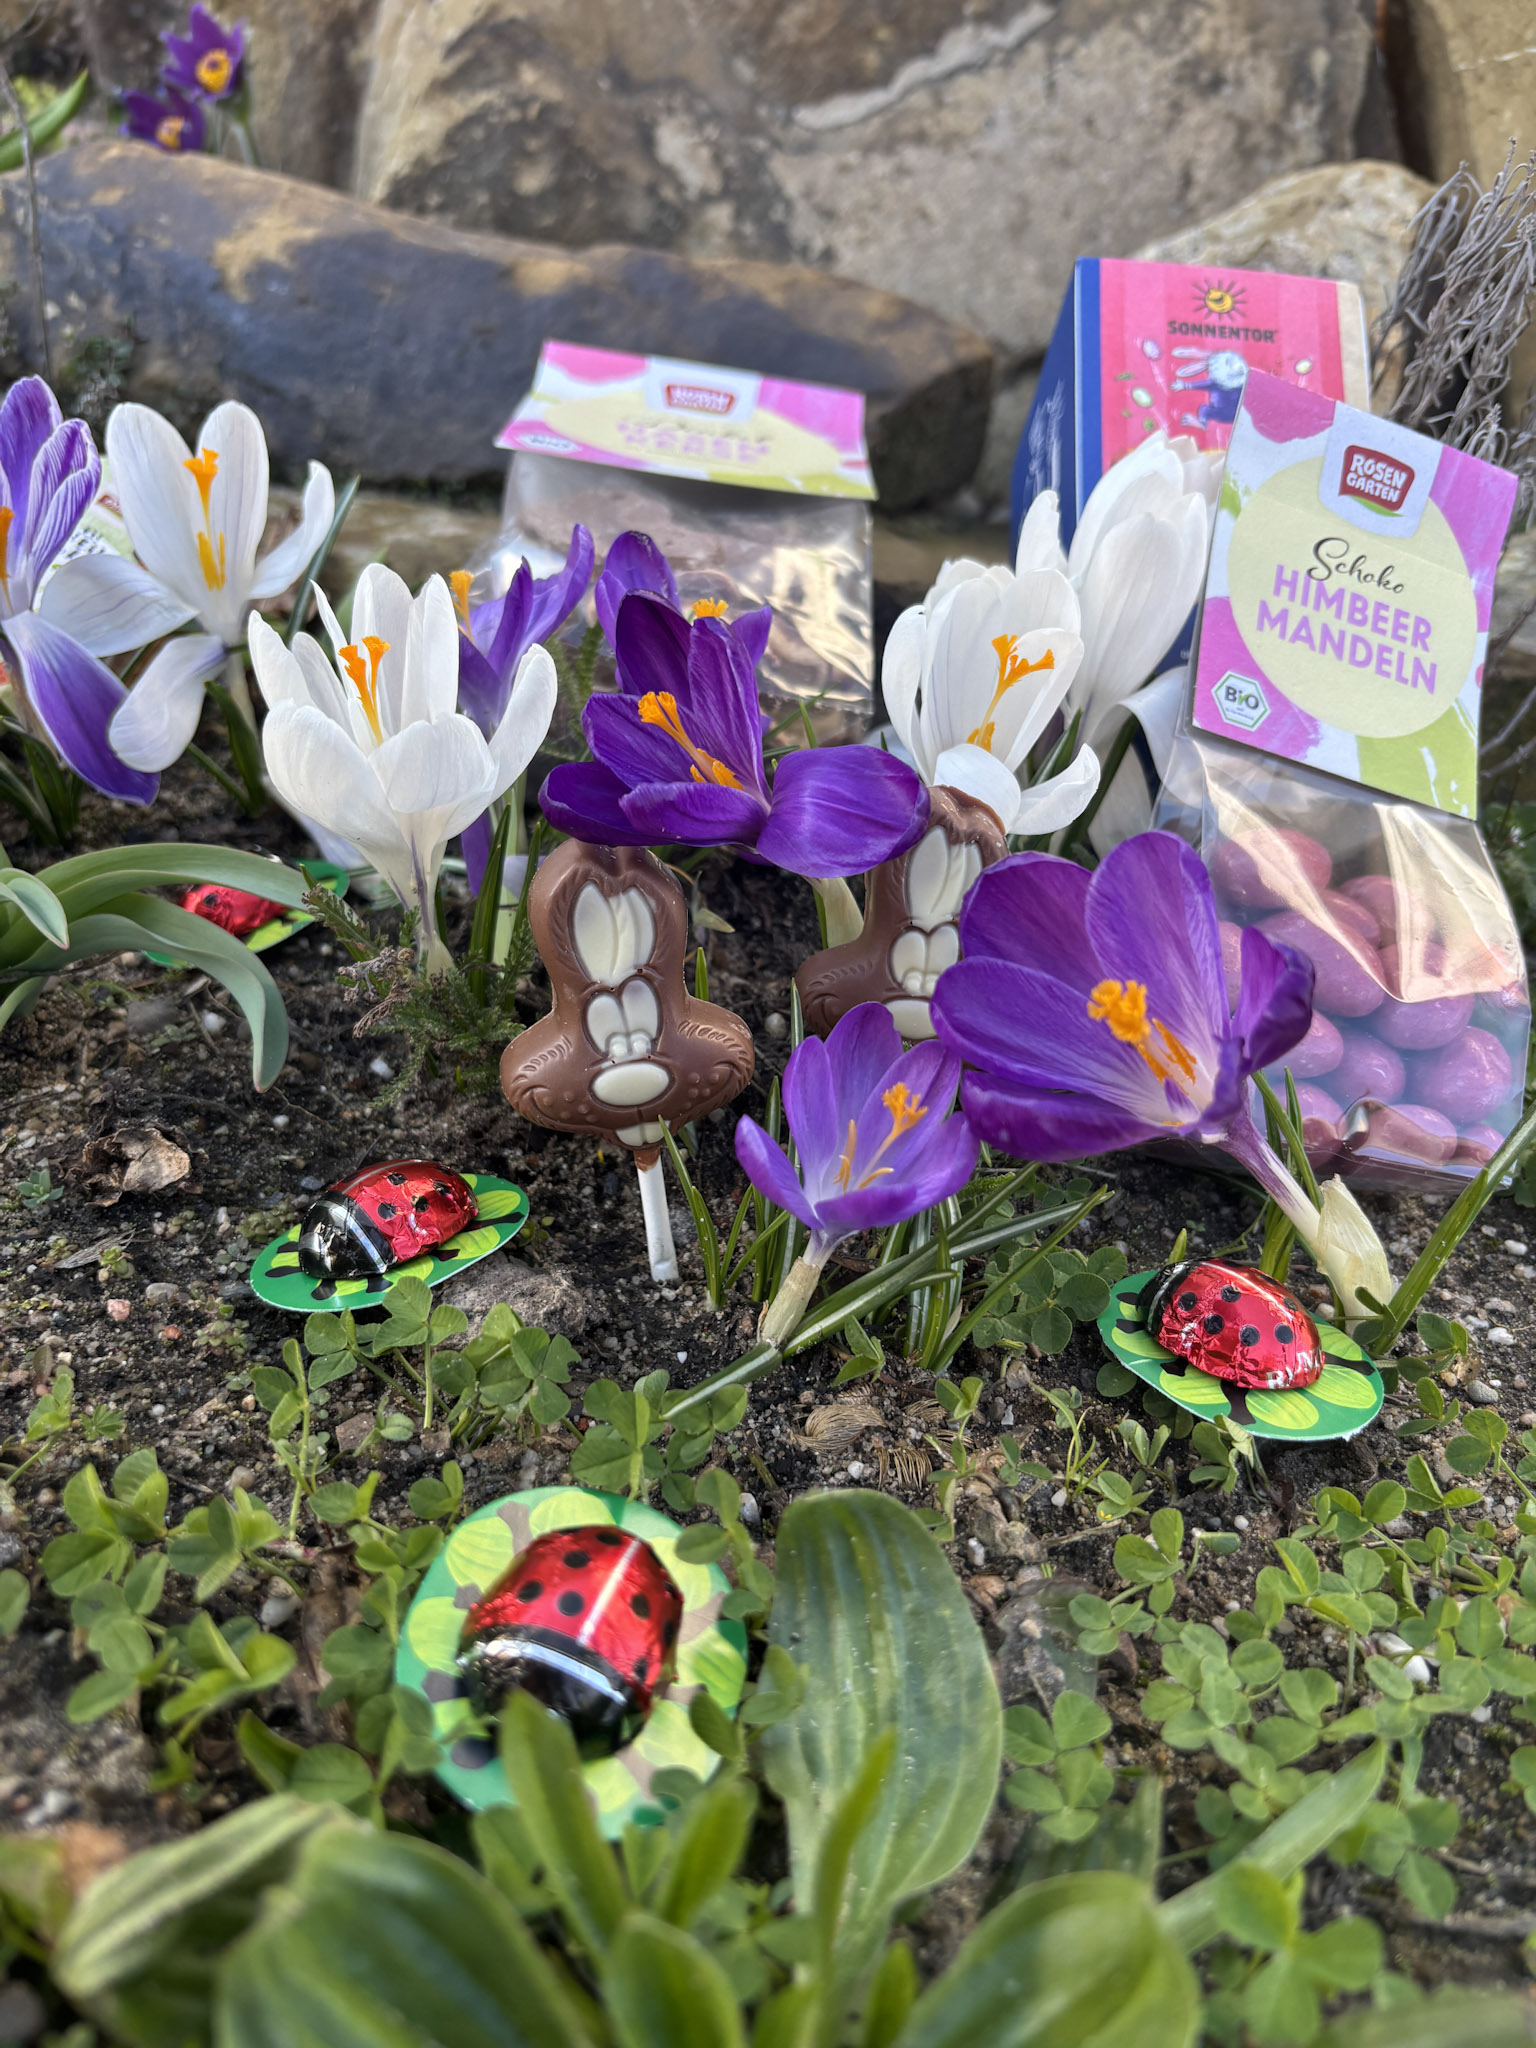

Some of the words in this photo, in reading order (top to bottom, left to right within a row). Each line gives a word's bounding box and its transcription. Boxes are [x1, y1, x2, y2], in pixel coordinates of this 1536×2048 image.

[1167, 320, 1275, 343] SONNENTOR
[1346, 472, 1400, 502] GARTEN
[1350, 453, 1407, 489] ROSEN
[1306, 537, 1405, 593] Schoko
[1273, 564, 1432, 652] HIMBEER
[1256, 599, 1437, 695] MANDELN
